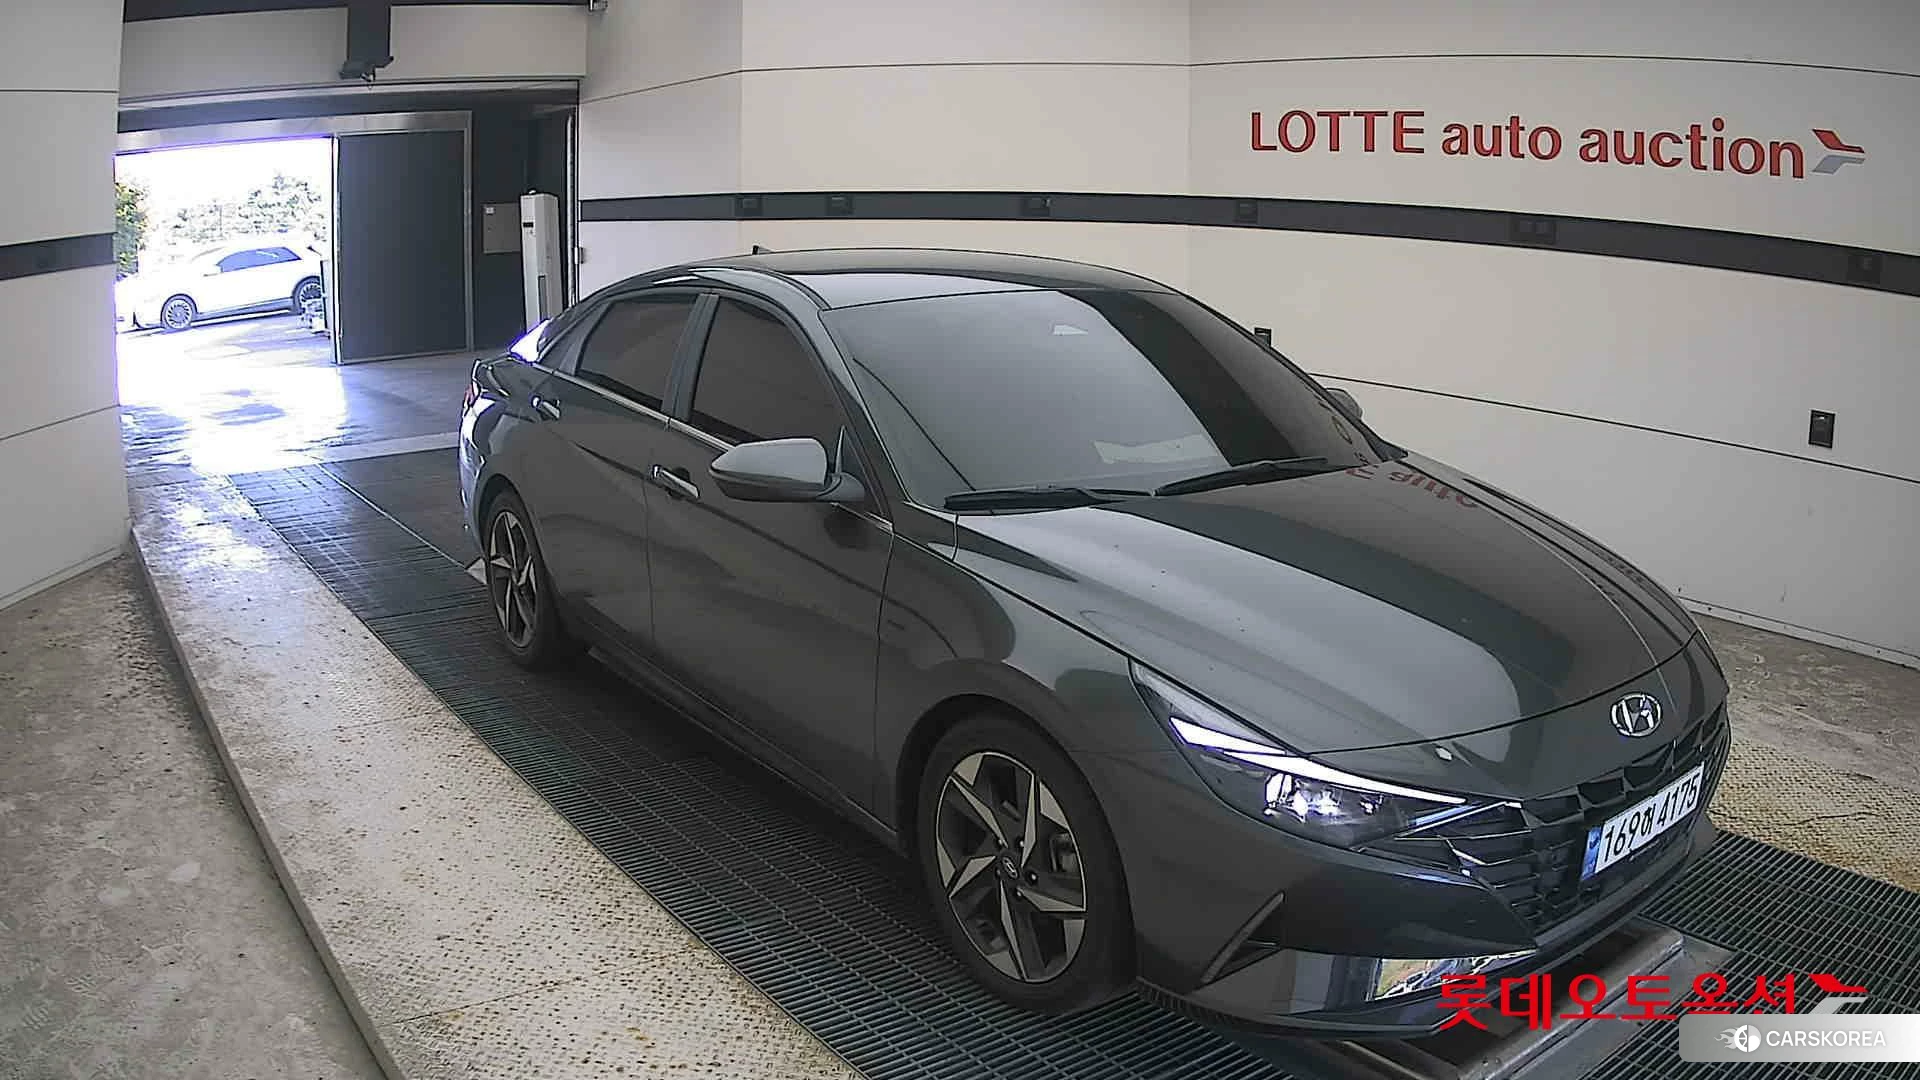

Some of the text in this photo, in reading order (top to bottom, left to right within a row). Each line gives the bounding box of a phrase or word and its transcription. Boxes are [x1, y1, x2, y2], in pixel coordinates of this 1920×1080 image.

[1251, 110, 1804, 180] LOTTE auto auction
[1656, 772, 1701, 827] 4175
